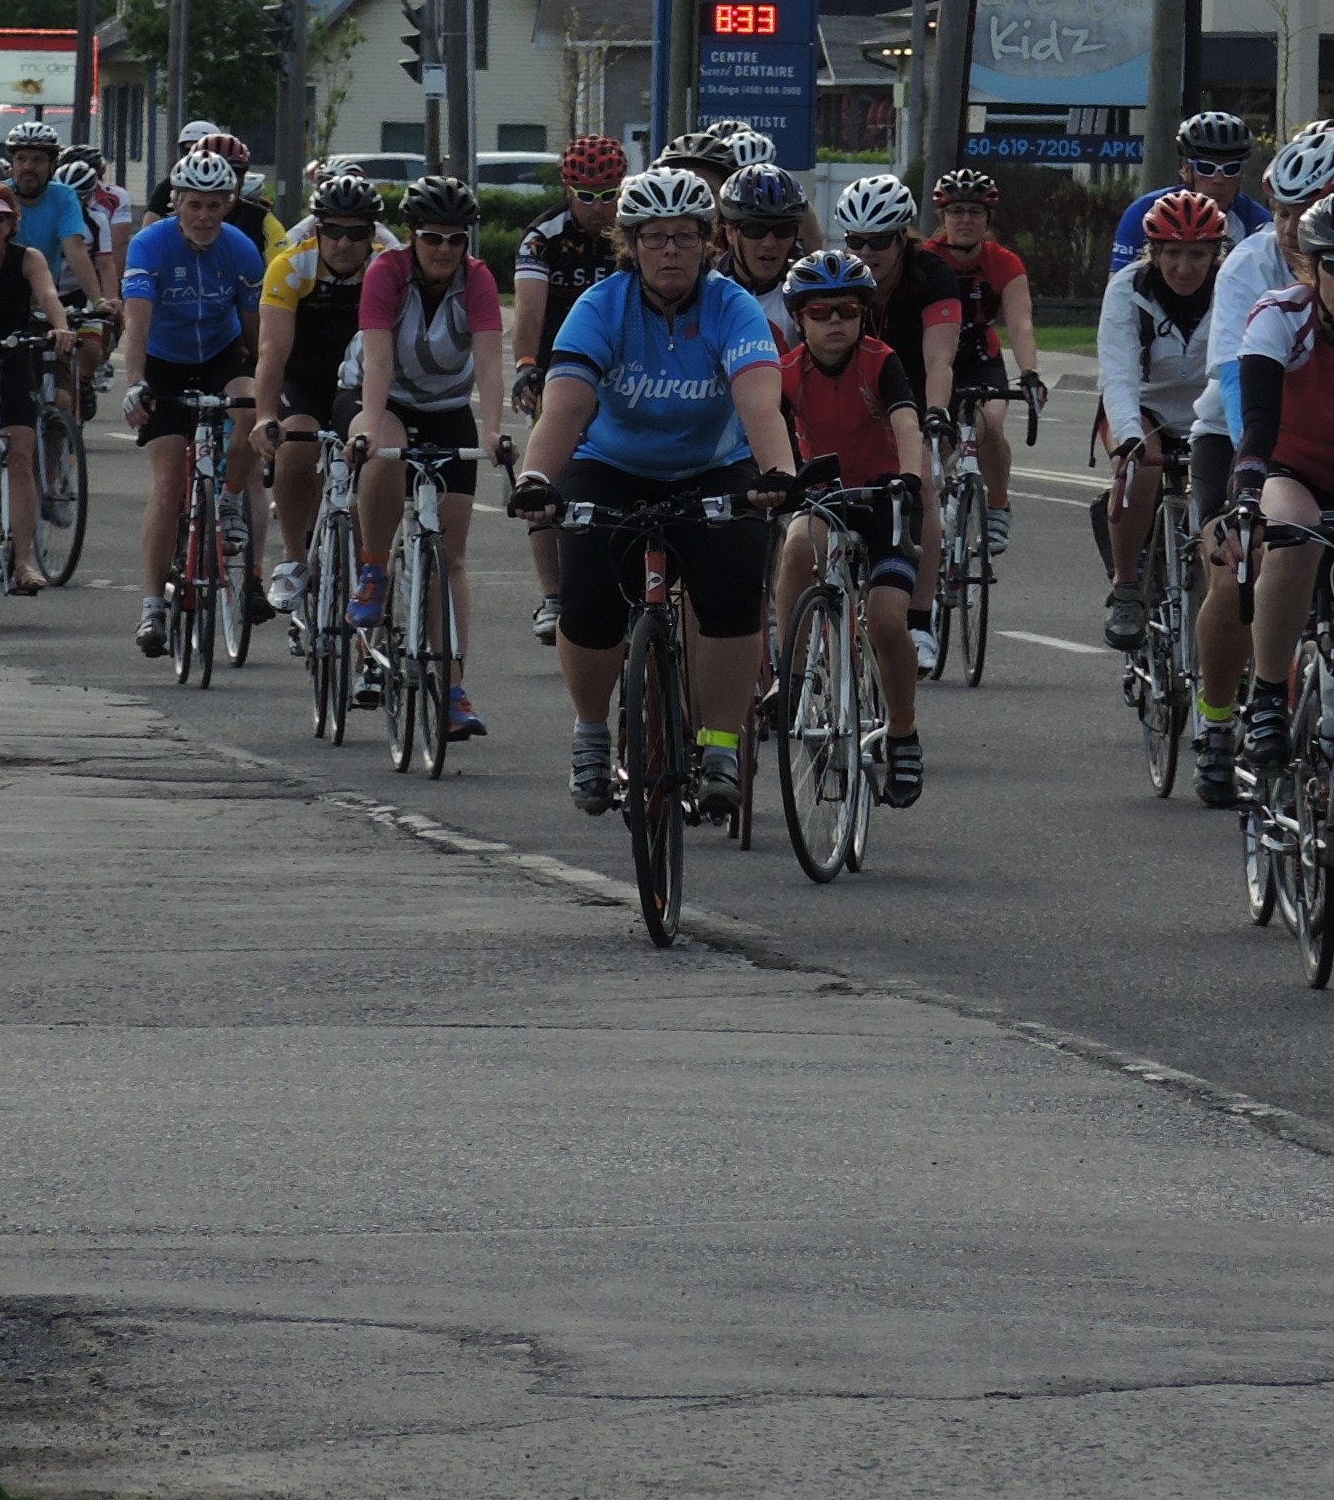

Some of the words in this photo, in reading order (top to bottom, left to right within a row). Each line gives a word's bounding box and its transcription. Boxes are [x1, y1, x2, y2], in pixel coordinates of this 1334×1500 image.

[715, 4, 776, 35] 8:33
[989, 15, 1107, 63] Kidz
[710, 51, 759, 63] CENTRE
[734, 65, 795, 78] DENTAIRE
[966, 138, 1082, 158] 50-619-7205
